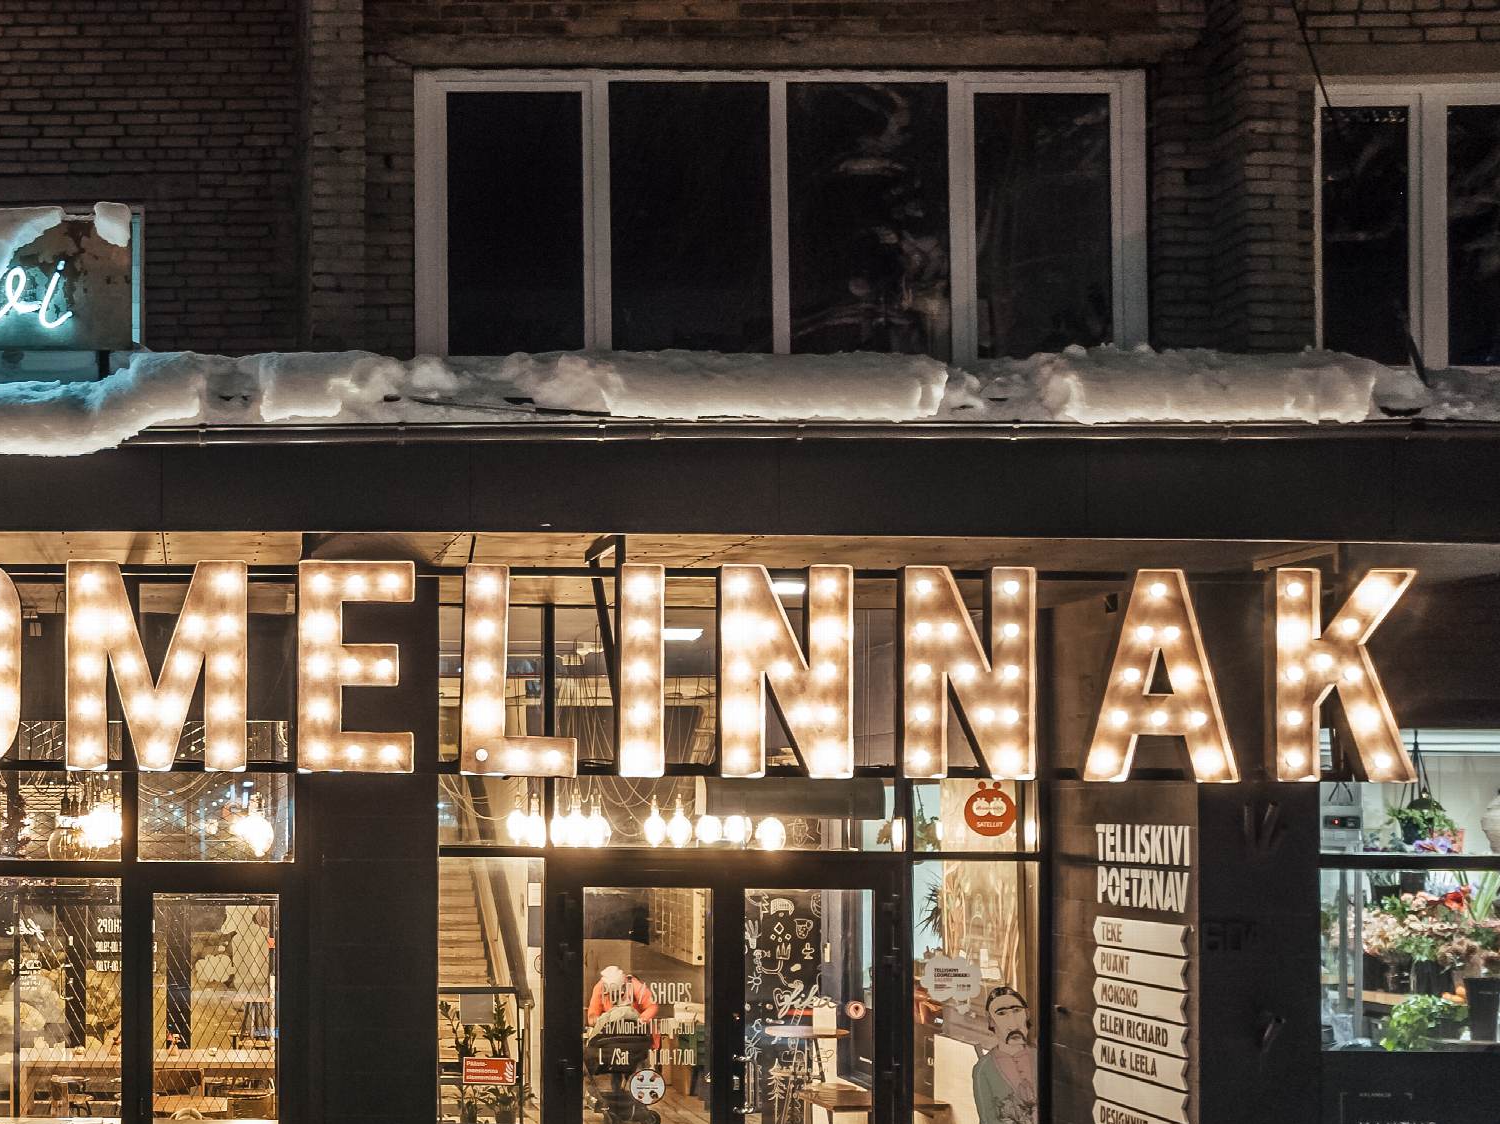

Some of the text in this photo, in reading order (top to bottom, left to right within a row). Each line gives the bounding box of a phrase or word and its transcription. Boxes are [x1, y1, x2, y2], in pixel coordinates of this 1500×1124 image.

[1095, 823, 1191, 866] TELLISKIVI
[1101, 922, 1122, 943] TEKE
[650, 982, 692, 1004] SHOPS
[1101, 983, 1138, 1008] MOKOKO
[1100, 1013, 1168, 1048] ELLEN RICHARD
[1100, 1044, 1157, 1078] MIA & LEELA
